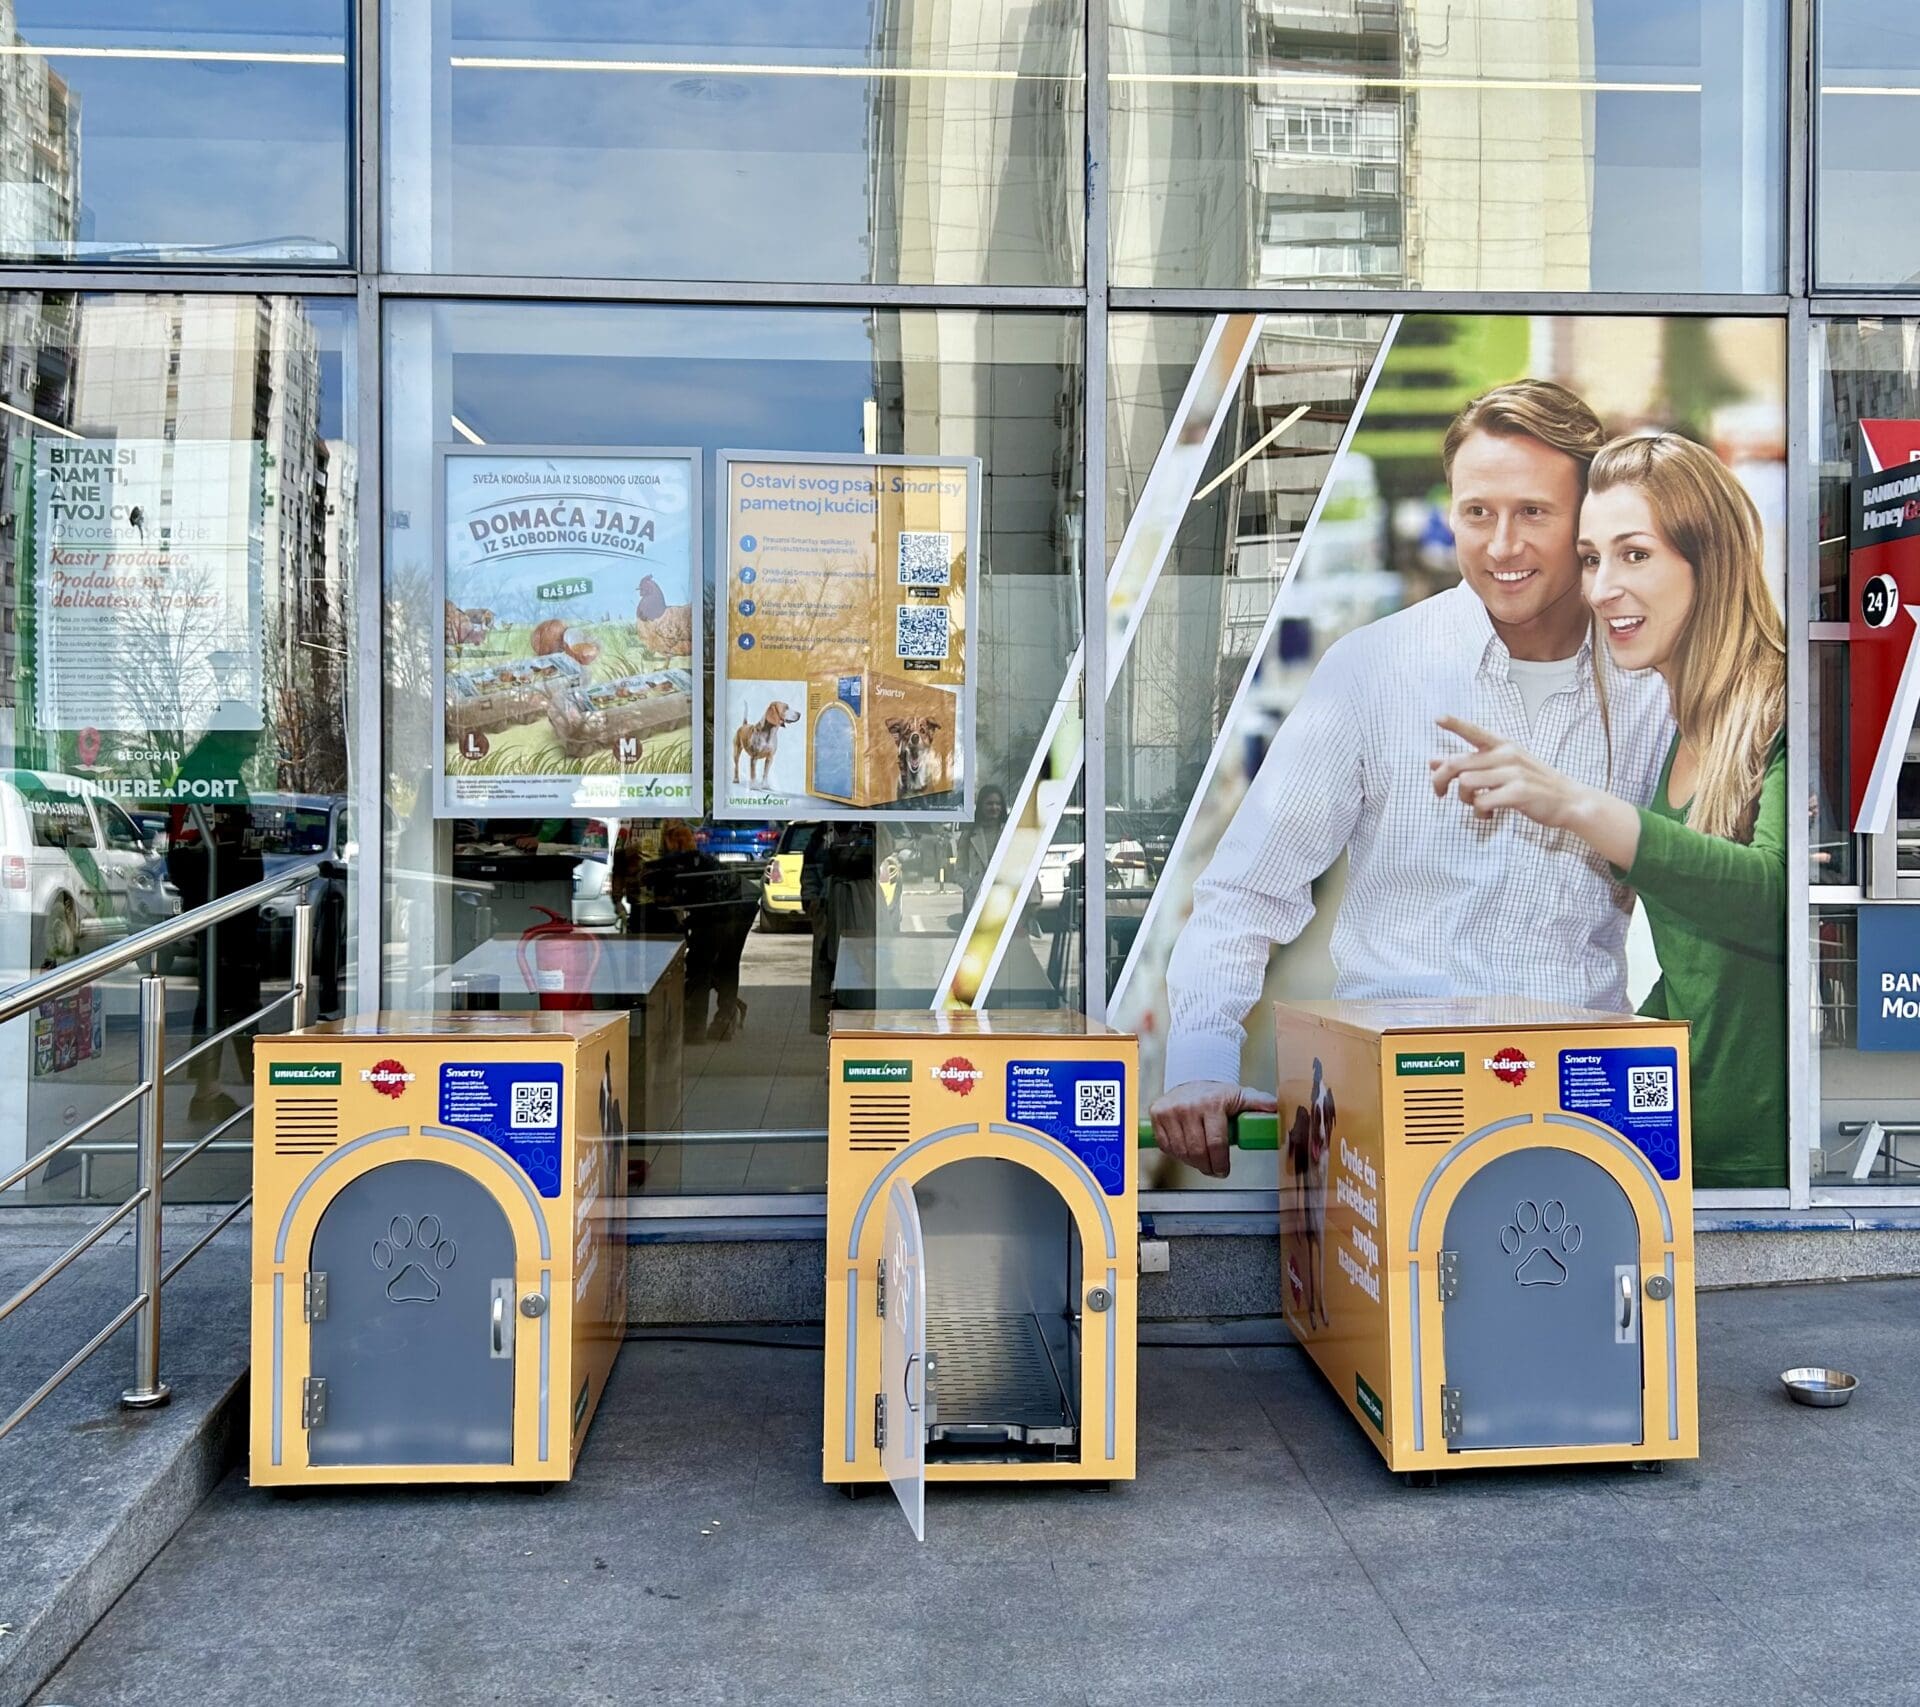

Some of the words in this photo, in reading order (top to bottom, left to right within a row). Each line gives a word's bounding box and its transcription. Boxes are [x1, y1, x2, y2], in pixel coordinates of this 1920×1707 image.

[50, 448, 113, 465] BITAN
[117, 448, 137, 465] SI
[50, 467, 99, 483] NAM
[104, 467, 128, 487] TI,
[472, 472, 499, 485] SVEŽA
[501, 472, 542, 485] KOKOŠIJA
[542, 474, 562, 486] JAJA
[563, 474, 571, 485] IZ
[573, 475, 626, 486] SLOBODNOG
[627, 475, 661, 486] UZGOJA
[740, 472, 796, 489] Ostavi
[799, 475, 840, 493] svog
[842, 478, 873, 493] psa
[877, 478, 886, 492] u
[891, 477, 962, 498] Smartsy
[50, 486, 66, 501] A
[71, 486, 101, 501] NE
[50, 504, 105, 520] TVOJ
[740, 497, 823, 516] pametnoj
[825, 497, 879, 514] kućici!
[469, 500, 586, 541] DOMAĆA
[594, 508, 655, 542] JAJA
[53, 523, 135, 539] Otvorene
[483, 540, 499, 554] IZ
[501, 530, 588, 550] SLOBODNOG
[591, 532, 646, 555] UZGOJA
[542, 586, 565, 598] BAŠ
[565, 581, 588, 595] BAŠ
[1867, 592, 1884, 612] 24
[875, 685, 906, 700] Smartsy
[468, 734, 480, 752] L
[619, 738, 637, 755] M
[118, 751, 181, 761] BEOGRAD
[729, 796, 790, 806] UNIVEREXPORT
[1881, 997, 1920, 1018] Mo
[1401, 1058, 1460, 1069] UNIVEREXPORT
[1482, 1057, 1536, 1073] Pedigree
[1564, 1054, 1602, 1065] Smartsy
[274, 1068, 337, 1078] UNIVEREXPORT
[358, 1069, 416, 1085] Pedigree
[446, 1068, 485, 1079] Smartsy
[848, 1065, 908, 1076] UNIVEREXPORT
[928, 1066, 984, 1082] Pedigree
[1012, 1065, 1050, 1077] Smartsy
[1340, 1136, 1363, 1181] Ovde
[1364, 1156, 1377, 1191] ću
[1336, 1174, 1378, 1229] pričekati
[1352, 1225, 1379, 1268] svoju
[1338, 1246, 1380, 1304] nagradu!
